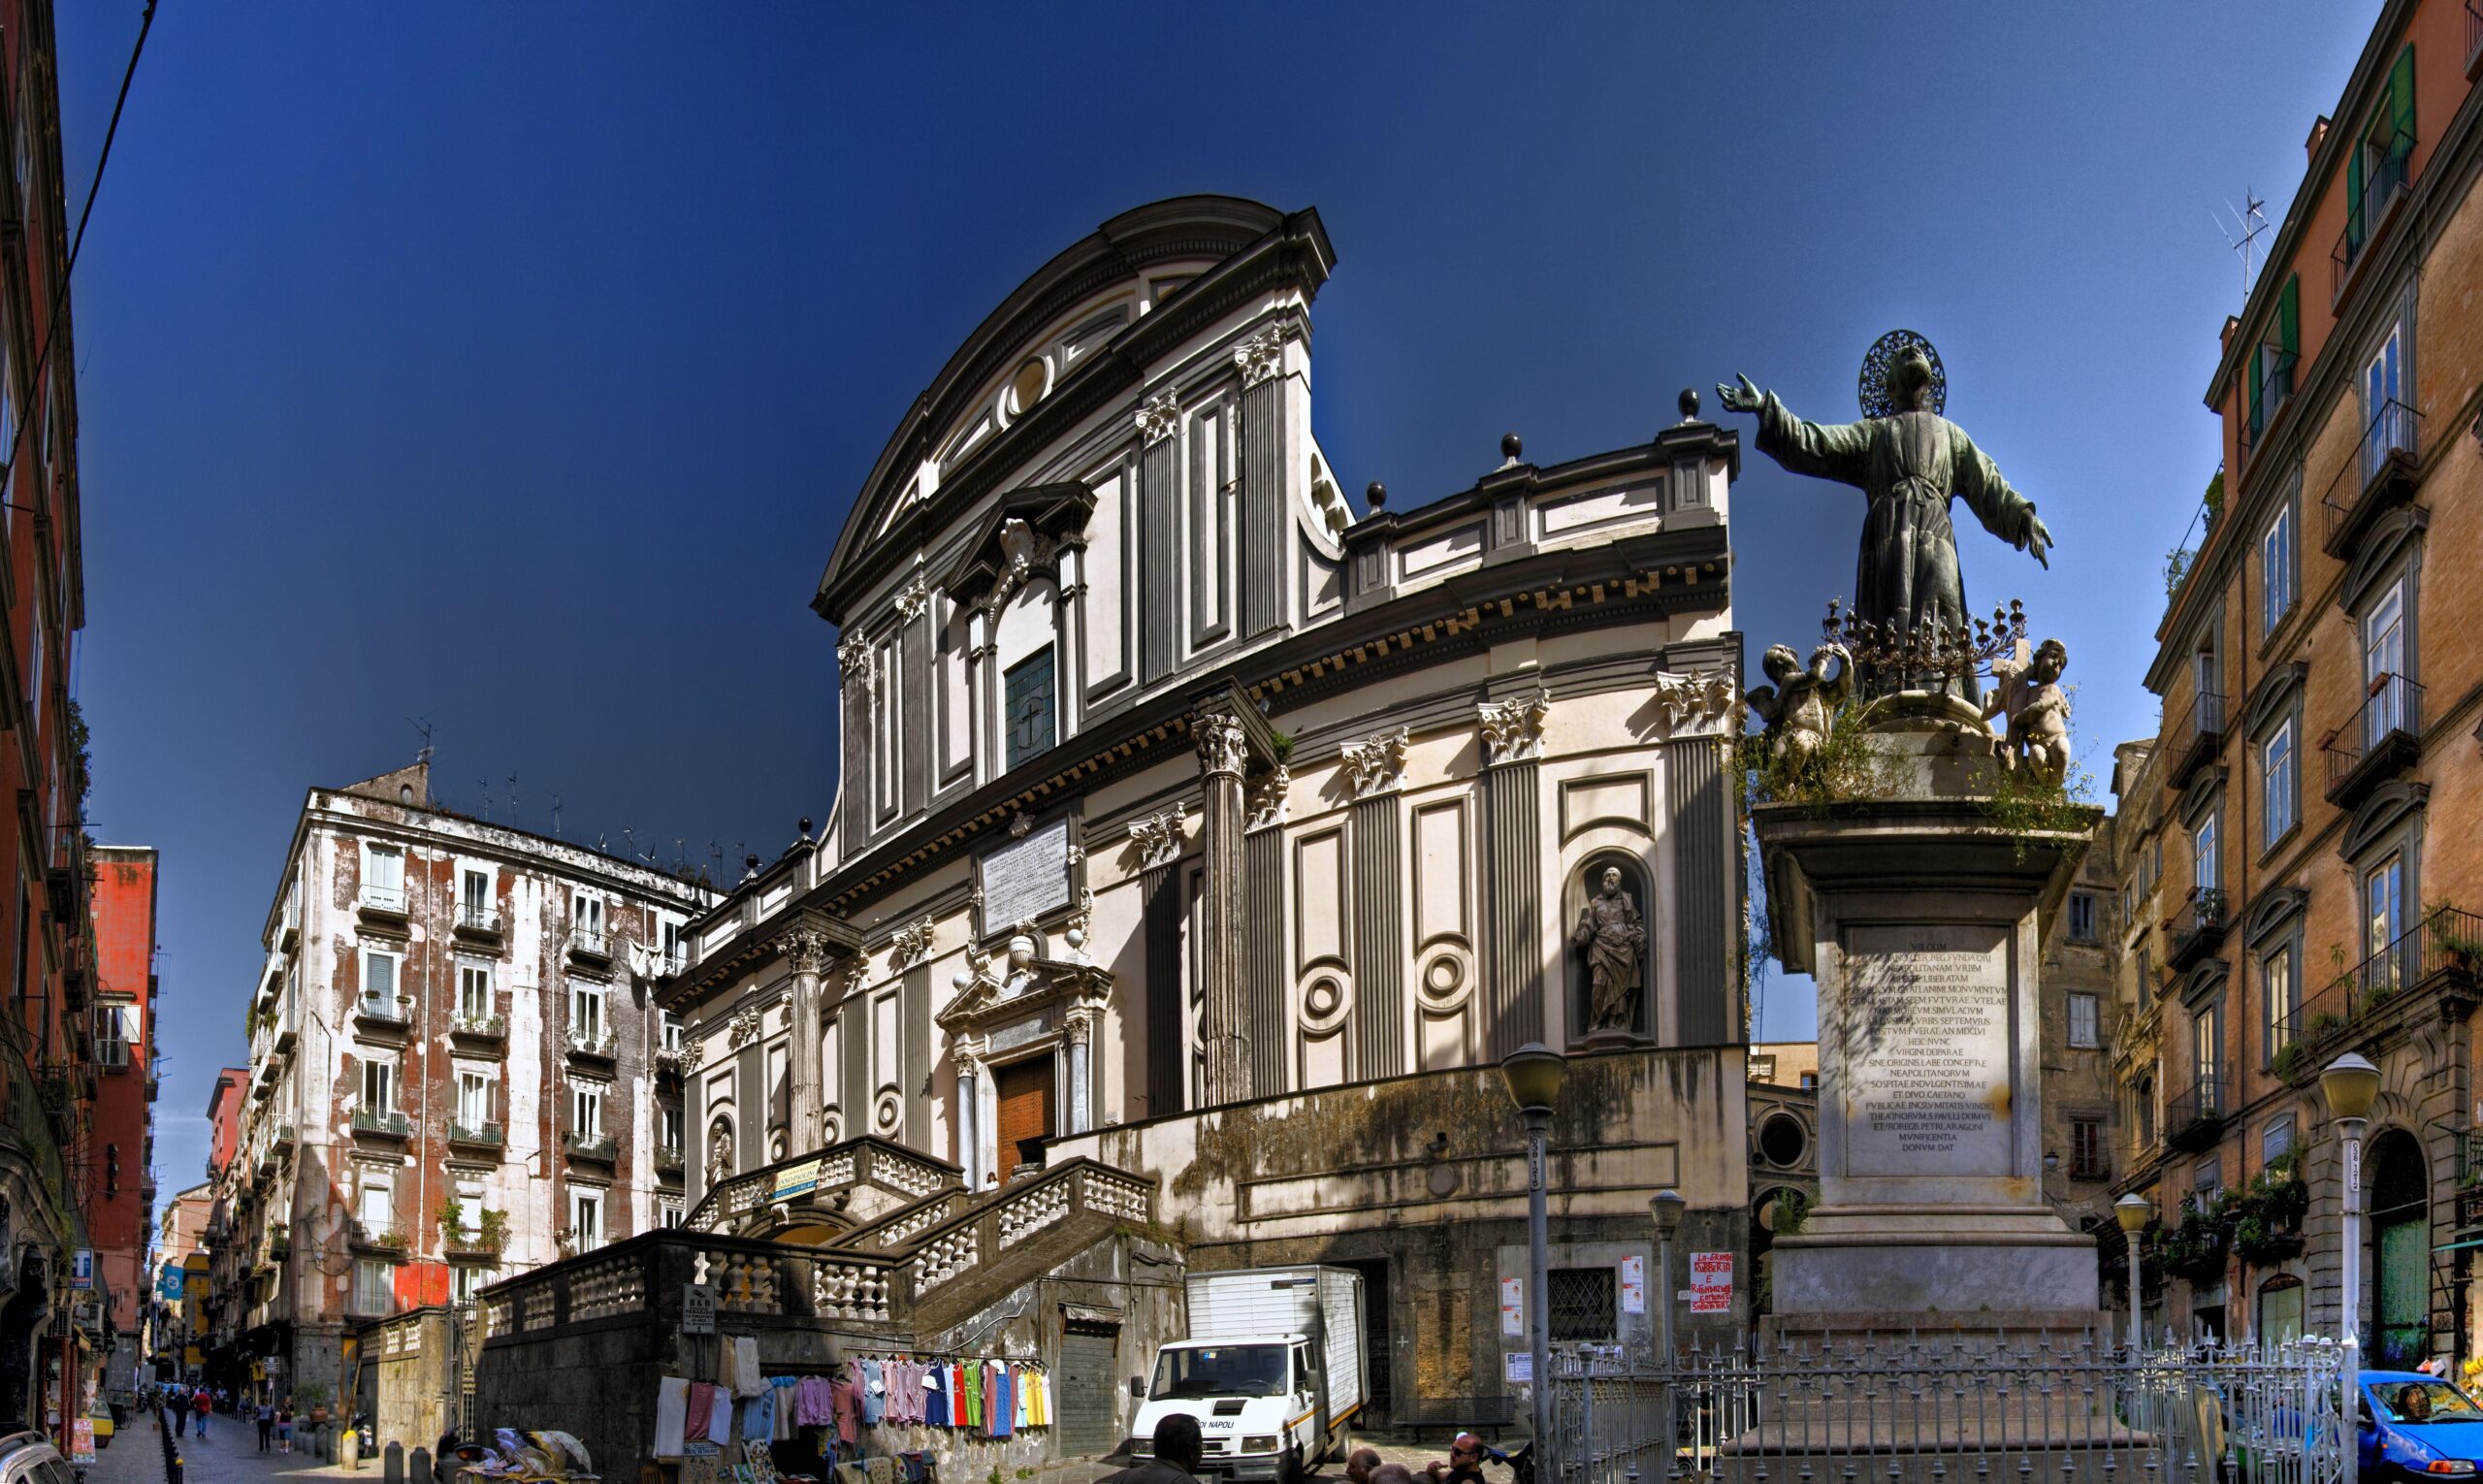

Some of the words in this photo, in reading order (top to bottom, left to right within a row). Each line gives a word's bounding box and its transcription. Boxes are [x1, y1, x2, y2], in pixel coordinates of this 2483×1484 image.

[1889, 1069, 1970, 1078] NEAPOLITANORVM
[1926, 1090, 1966, 1099] CAETANO
[1902, 1144, 1936, 1152] DONVM
[1938, 1144, 1955, 1152] DAT
